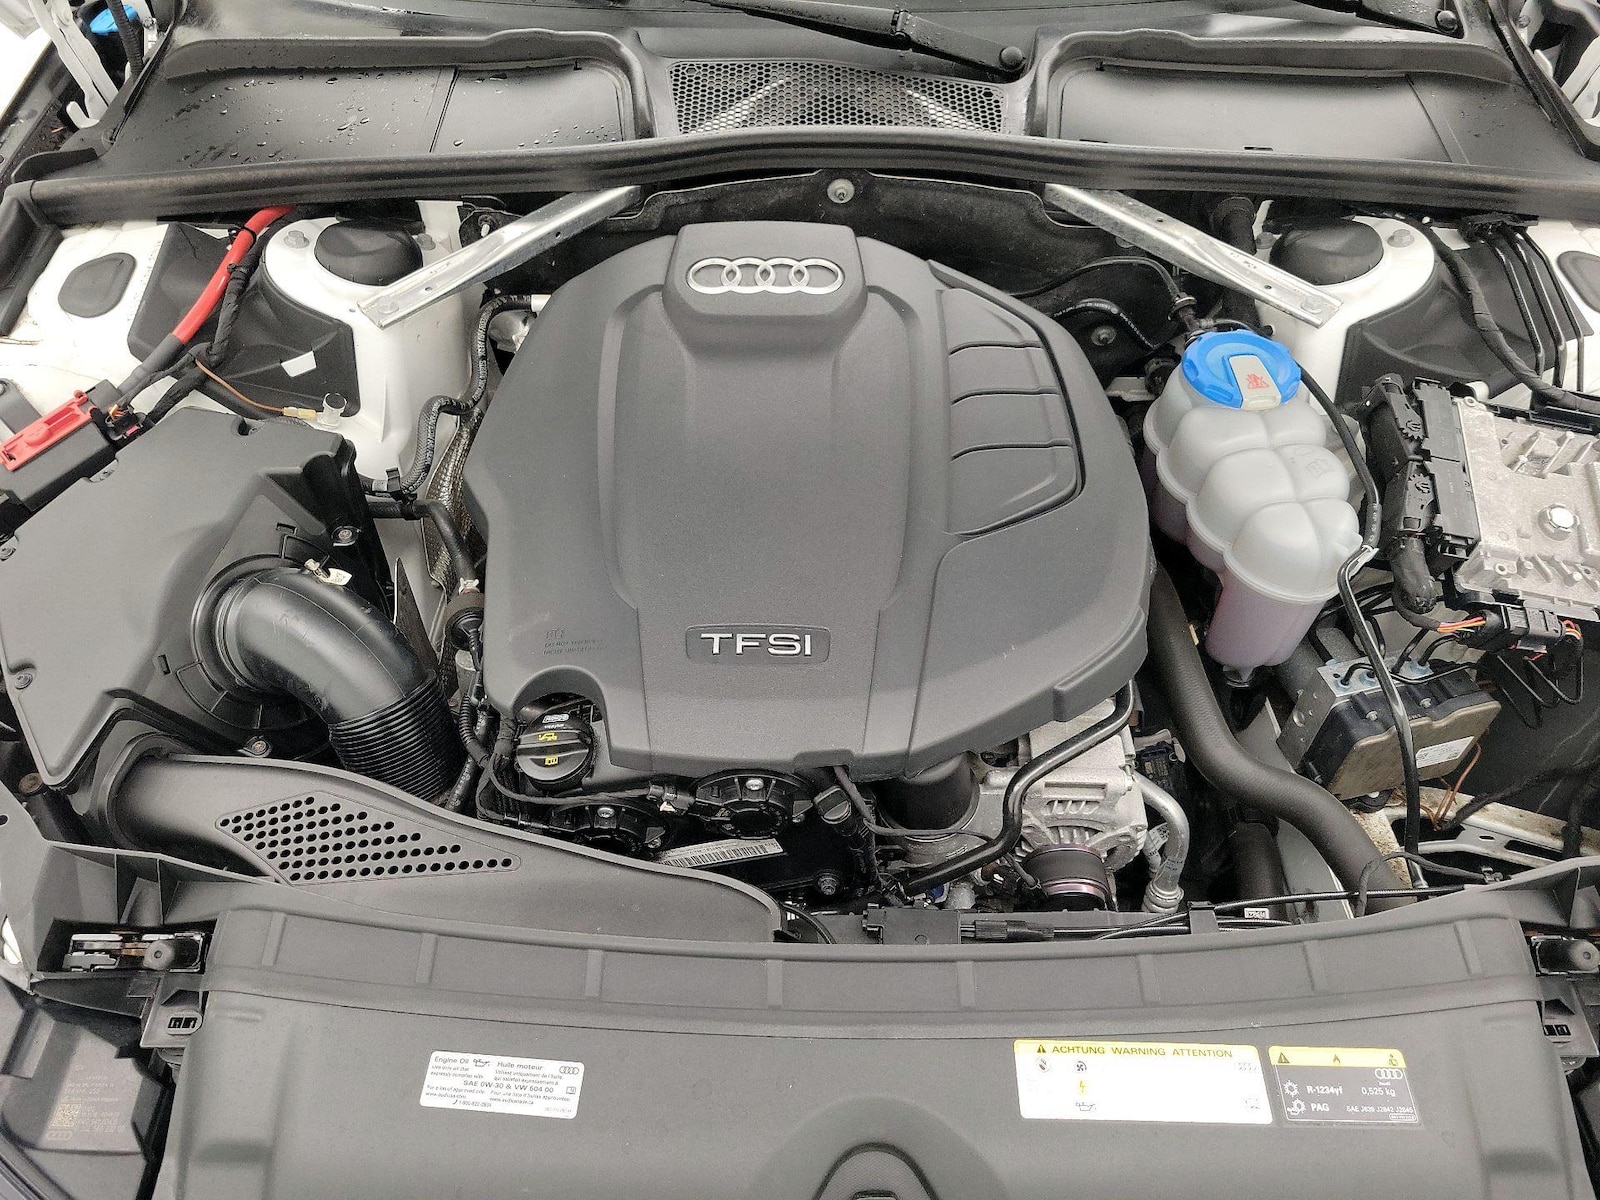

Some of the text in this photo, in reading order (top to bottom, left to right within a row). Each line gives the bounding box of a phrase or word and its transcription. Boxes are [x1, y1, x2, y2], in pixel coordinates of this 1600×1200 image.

[700, 633, 812, 656] TFSI
[1052, 1045, 1233, 1058] ACHTUNG WARNING ATTENTION
[434, 1055, 458, 1064] Engine
[497, 1061, 543, 1071] Huile moteur
[480, 1081, 504, 1089] 0W-30
[1306, 1085, 1396, 1097] R-1234yf 0,525 kg
[1310, 1102, 1330, 1112] PAG
